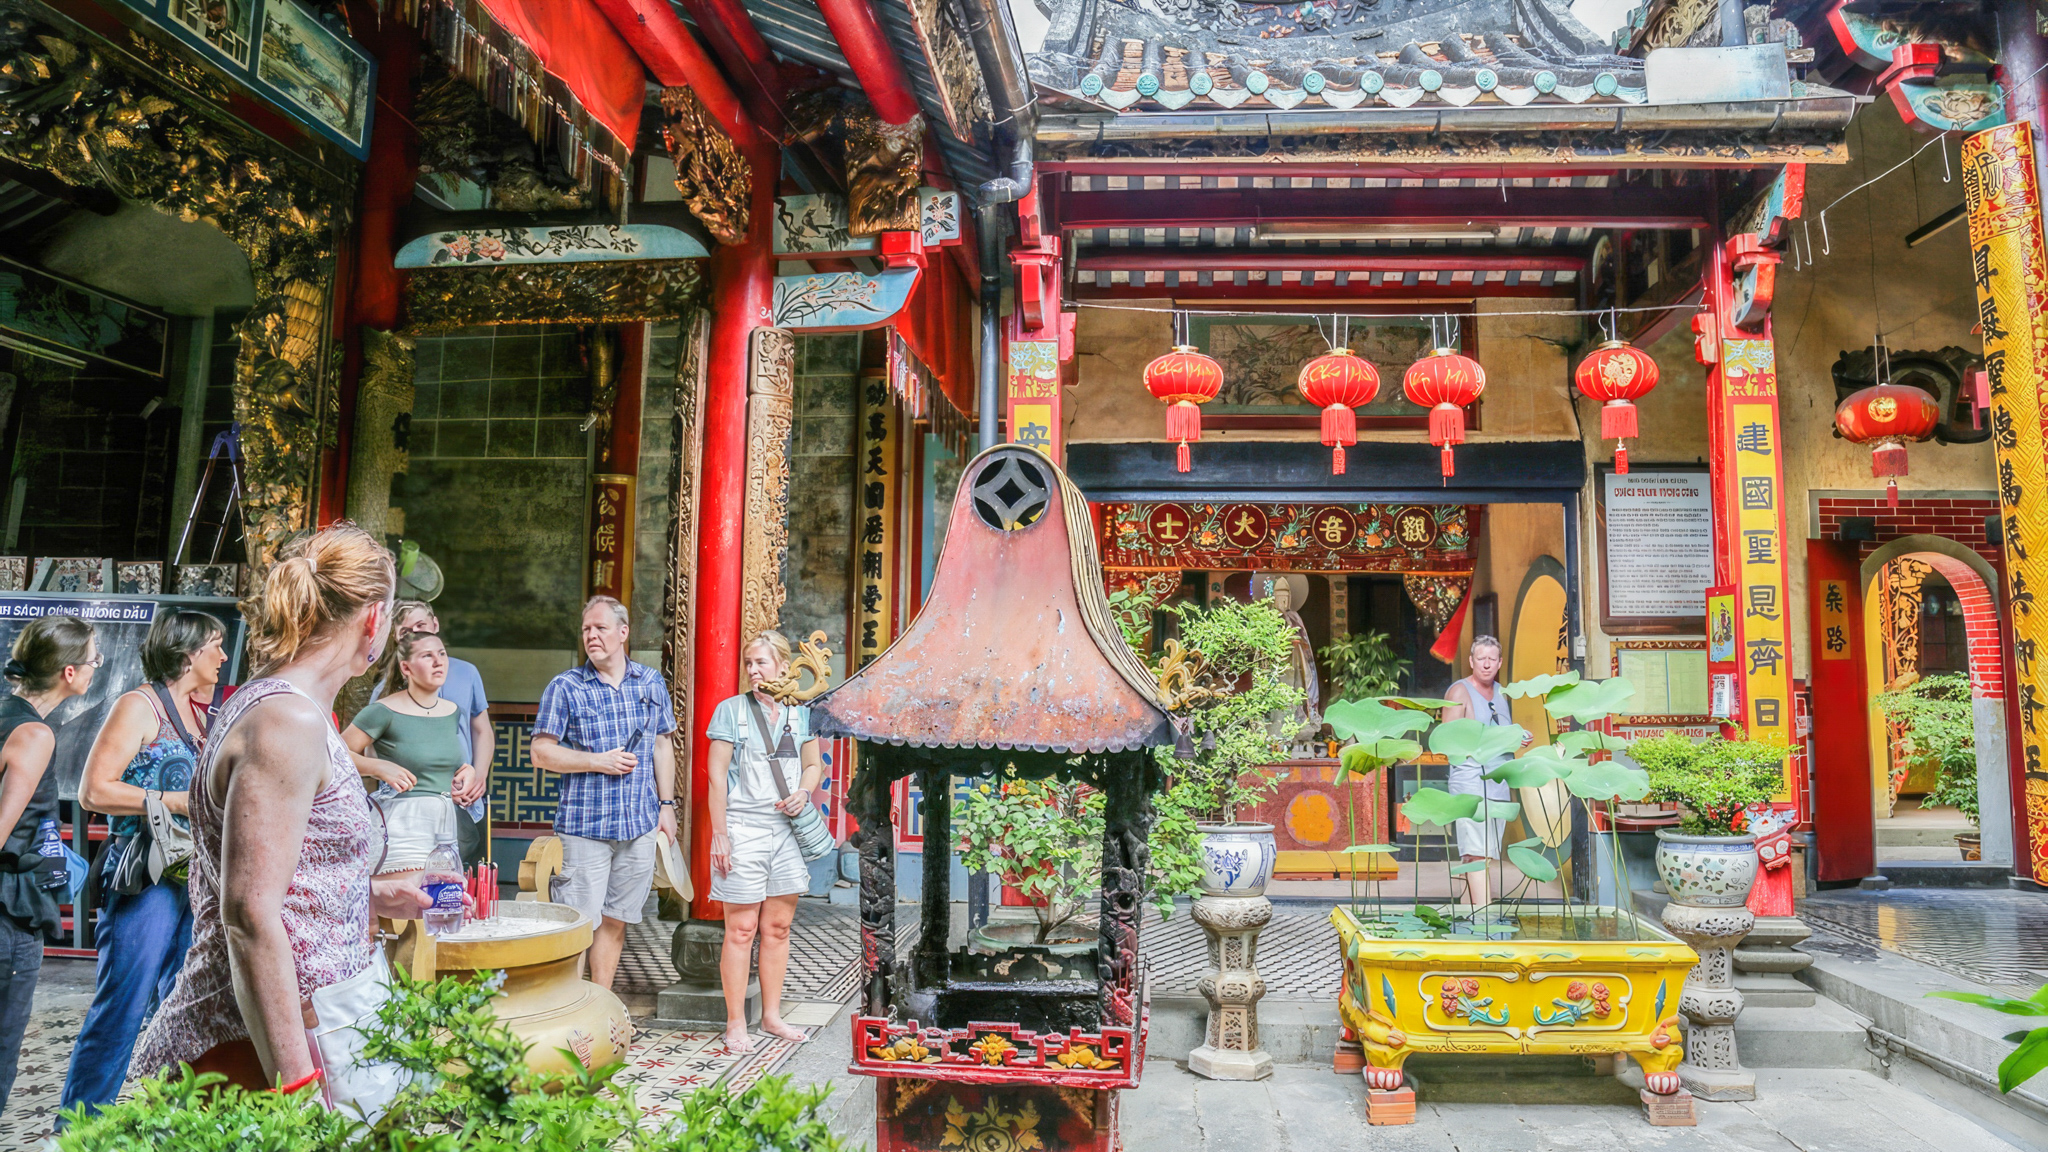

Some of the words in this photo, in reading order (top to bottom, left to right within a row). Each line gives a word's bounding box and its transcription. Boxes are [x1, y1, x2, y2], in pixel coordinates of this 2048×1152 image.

[1737, 422, 1784, 786] 建國聖恩齊日
